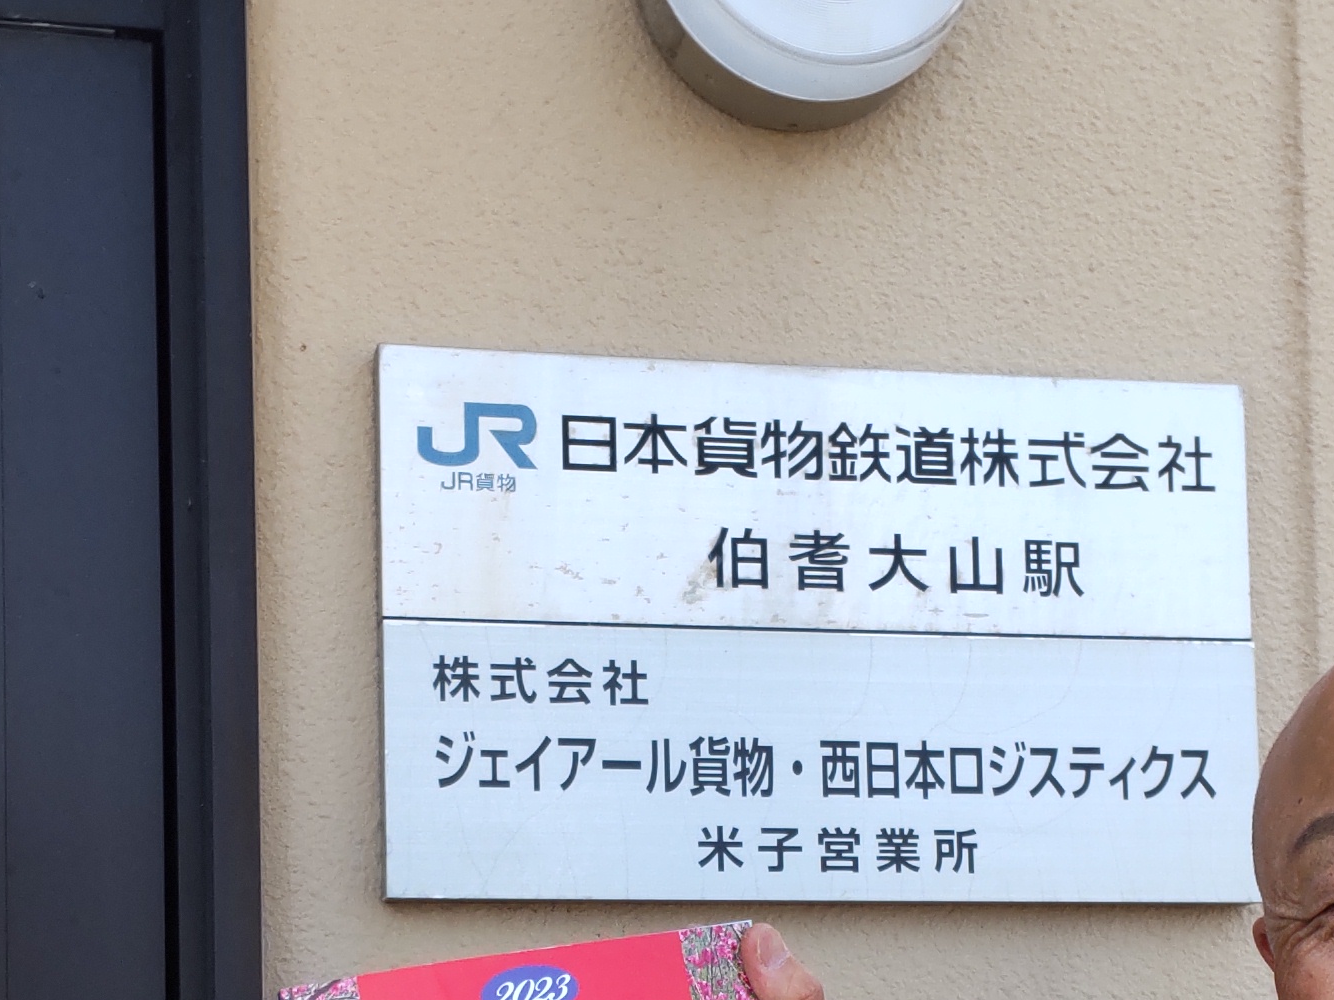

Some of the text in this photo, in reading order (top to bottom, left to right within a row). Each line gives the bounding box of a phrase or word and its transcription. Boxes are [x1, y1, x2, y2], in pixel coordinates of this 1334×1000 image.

[417, 402, 538, 469] JR
[562, 413, 1216, 492] 日本貨物鉄道株式会社
[441, 472, 516, 492] JR貨物
[708, 527, 1085, 597] 伯耆大山駅
[433, 655, 649, 705] 株式会社
[435, 731, 1217, 800] ジェイアール貨物・西日本ロジスティクス
[698, 825, 978, 874] 米子営業所
